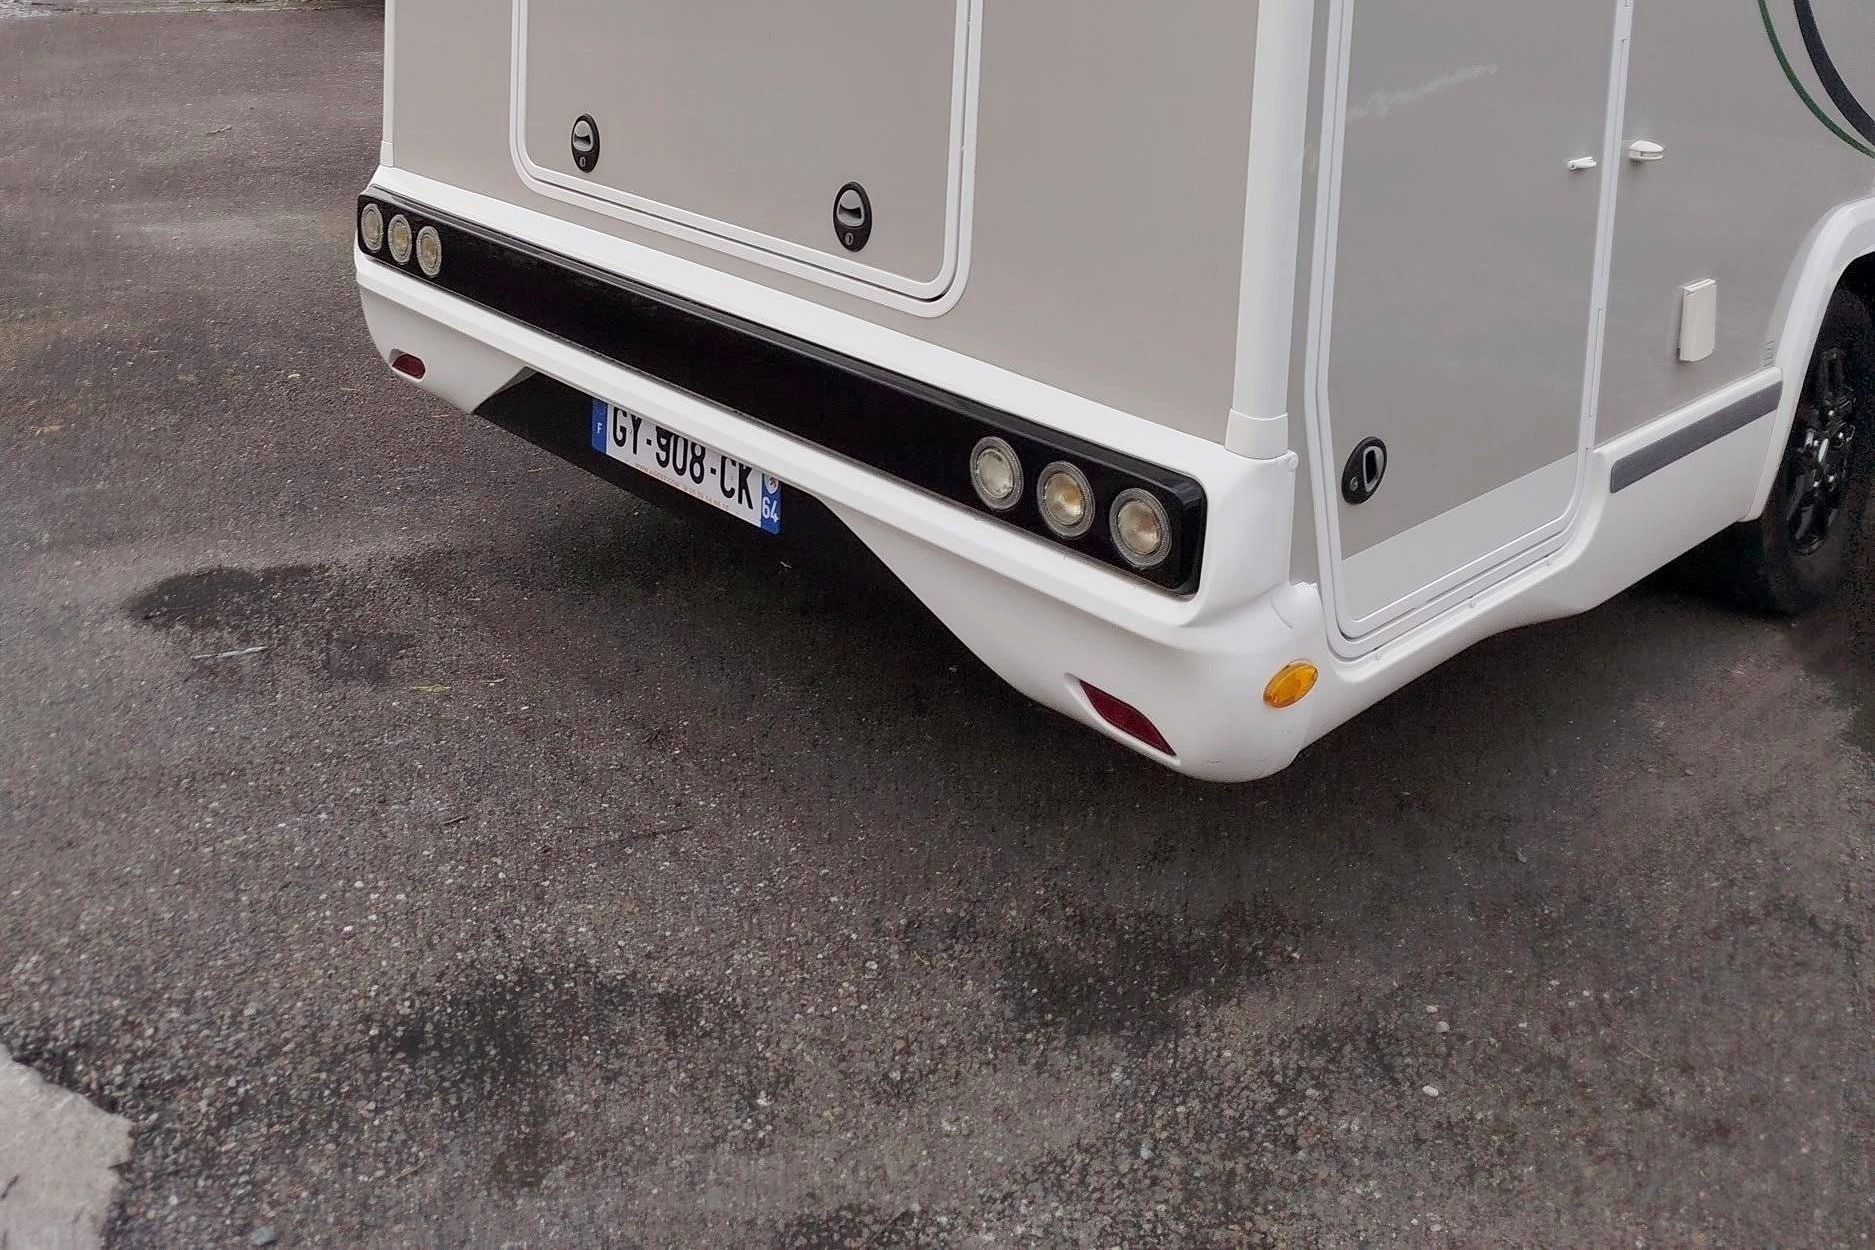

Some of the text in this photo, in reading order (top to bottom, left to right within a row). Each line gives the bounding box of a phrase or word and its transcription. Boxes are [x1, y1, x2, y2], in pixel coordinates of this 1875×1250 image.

[597, 422, 603, 434] F
[612, 406, 753, 510] GY-908-CK
[762, 496, 780, 523] 64
